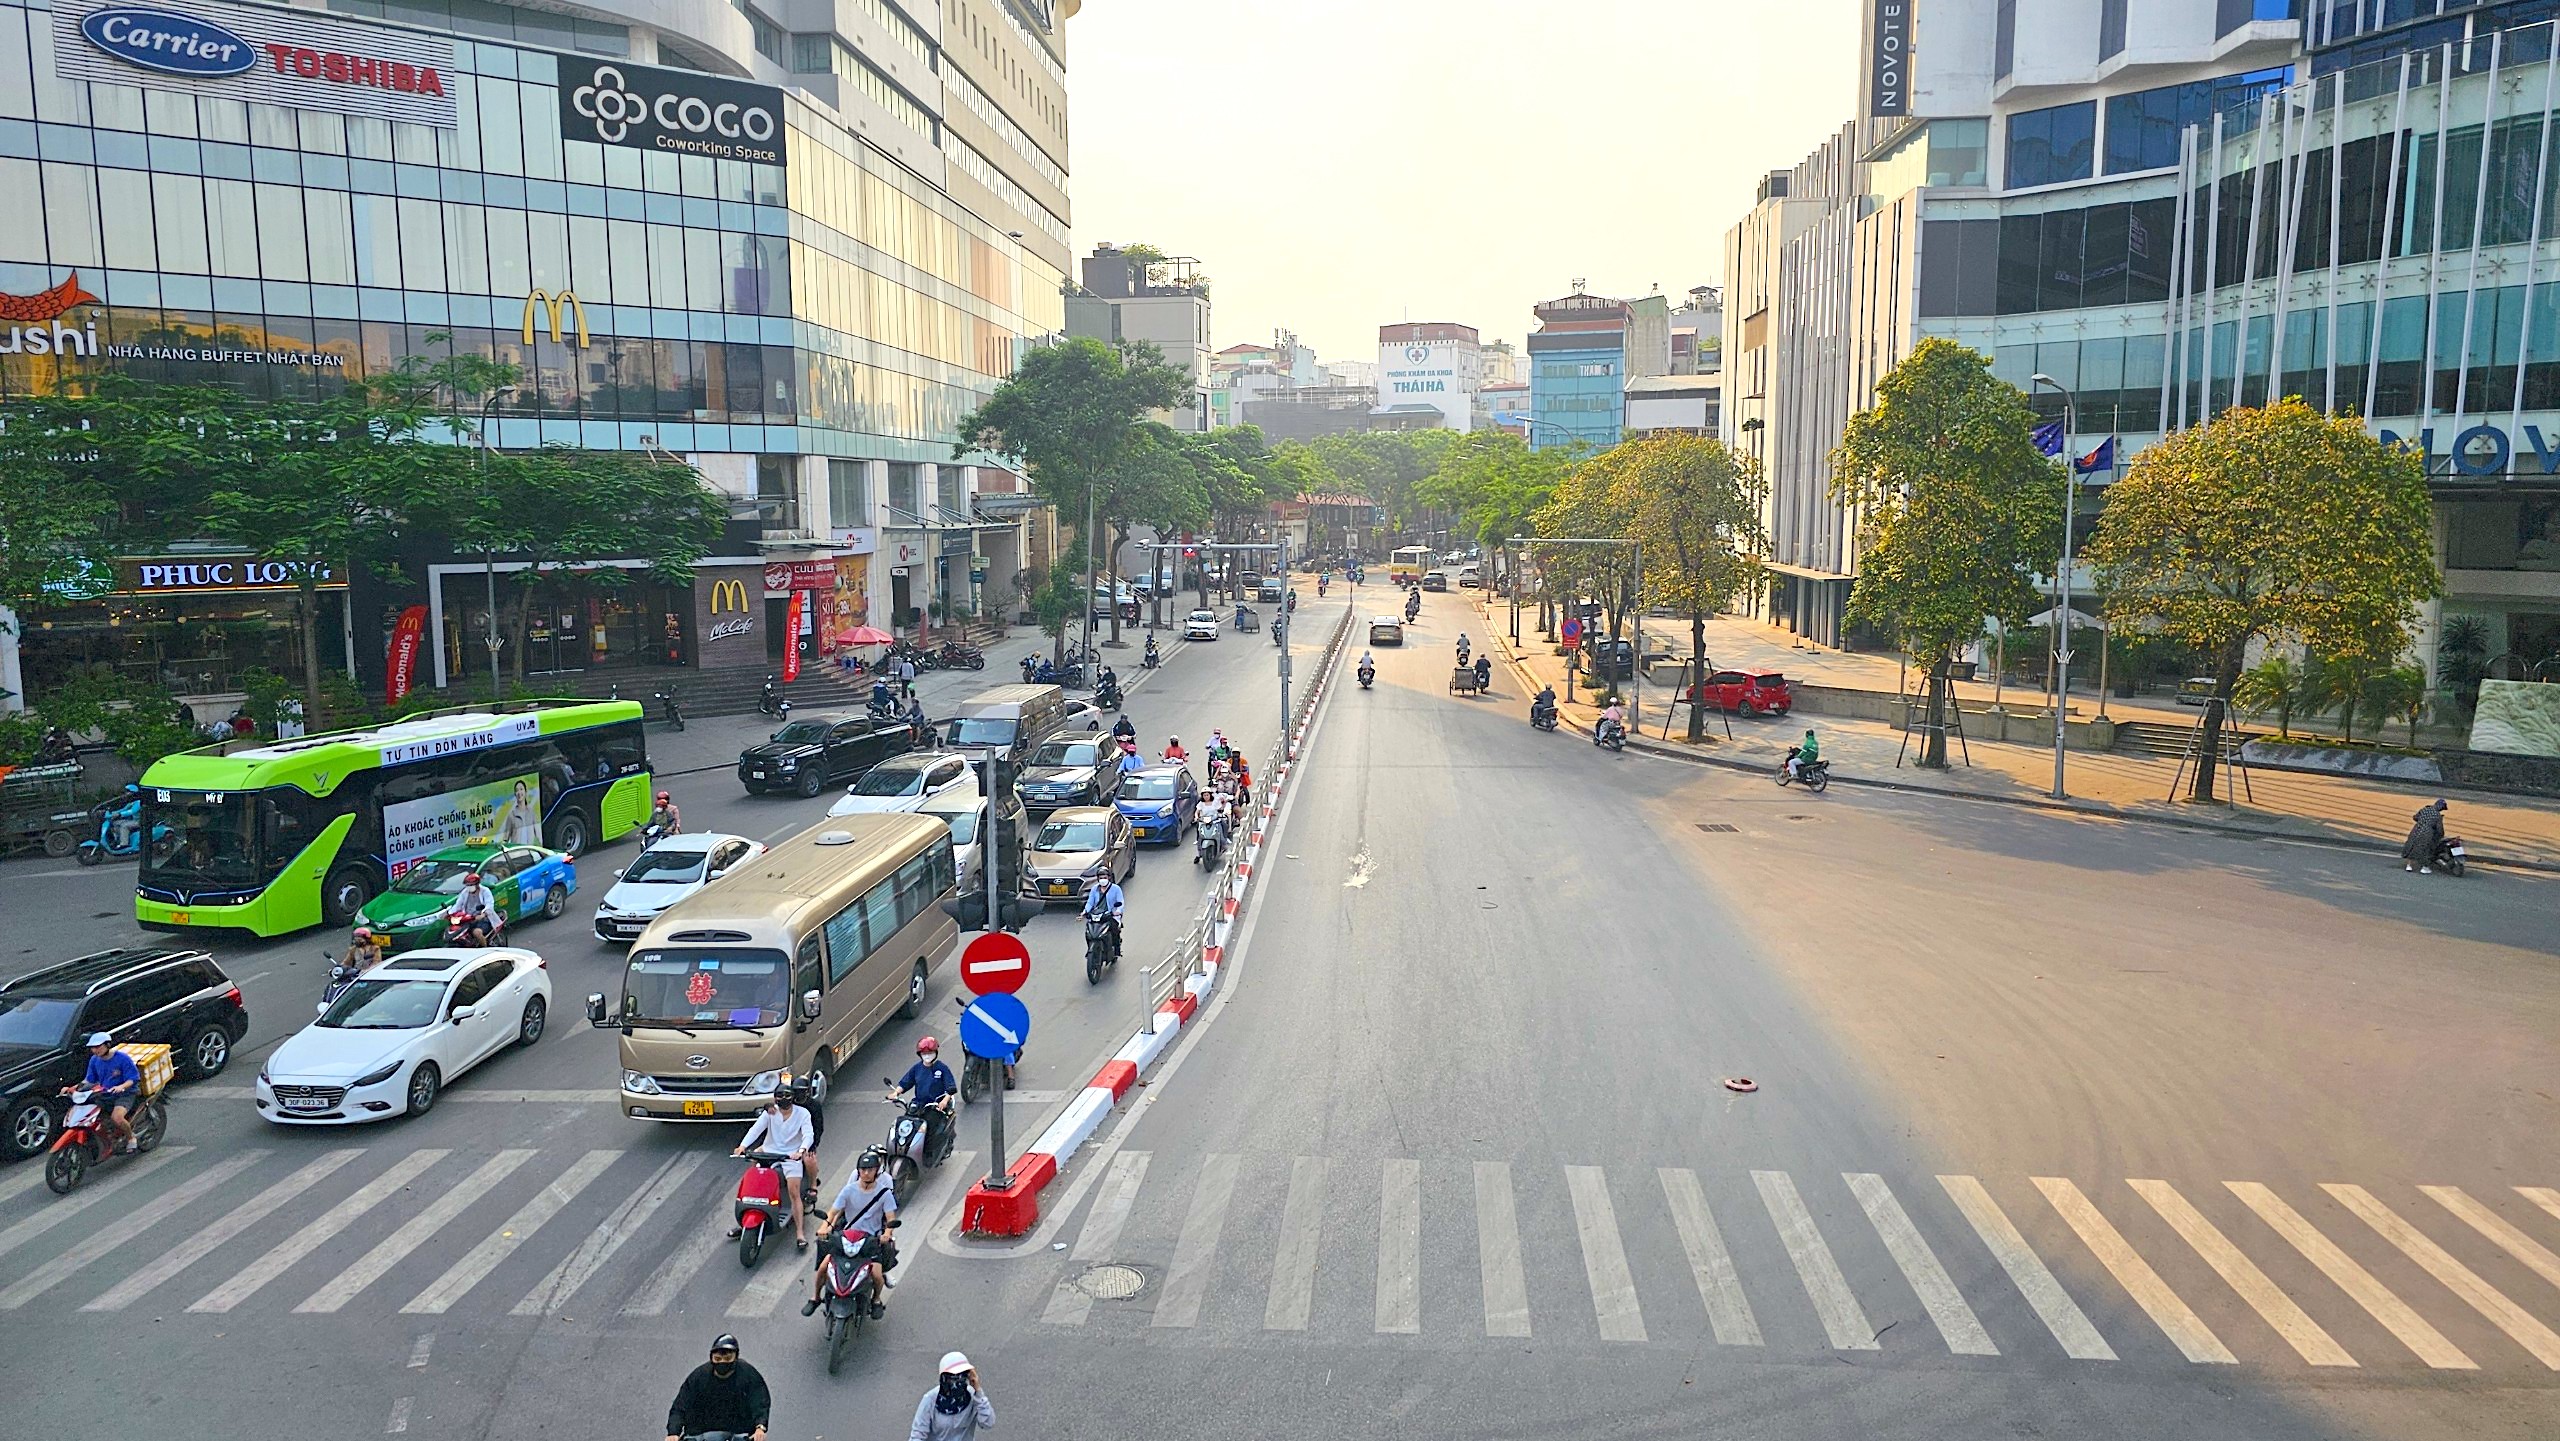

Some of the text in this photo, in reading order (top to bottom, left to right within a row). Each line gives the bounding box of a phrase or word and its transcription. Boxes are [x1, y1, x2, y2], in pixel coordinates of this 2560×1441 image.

[102, 16, 238, 64] Carrier
[1881, 5, 1900, 107] NOVOTE
[264, 43, 444, 97] TOSHIBA
[654, 93, 774, 142] COGO
[656, 135, 776, 162] Coworking Space
[108, 345, 344, 367] NHÀ HÀNG BUFFET NHẬT BẢN
[1387, 370, 1407, 378] PHÒNG
[1408, 369, 1425, 377] KHÁM
[1393, 378, 1445, 393] THÁI HÀ
[141, 563, 233, 587] PHUC
[788, 616, 798, 674] McDonald's
[395, 634, 413, 698] McDonald's
[386, 749, 402, 763] TỰ
[409, 745, 429, 759] TIN
[157, 790, 171, 803] E03
[388, 803, 493, 839] ÁO KHOÁC CHỐNG NẮNG
[389, 818, 494, 854] CÔNG NGHỆ NHẬT BẢN
